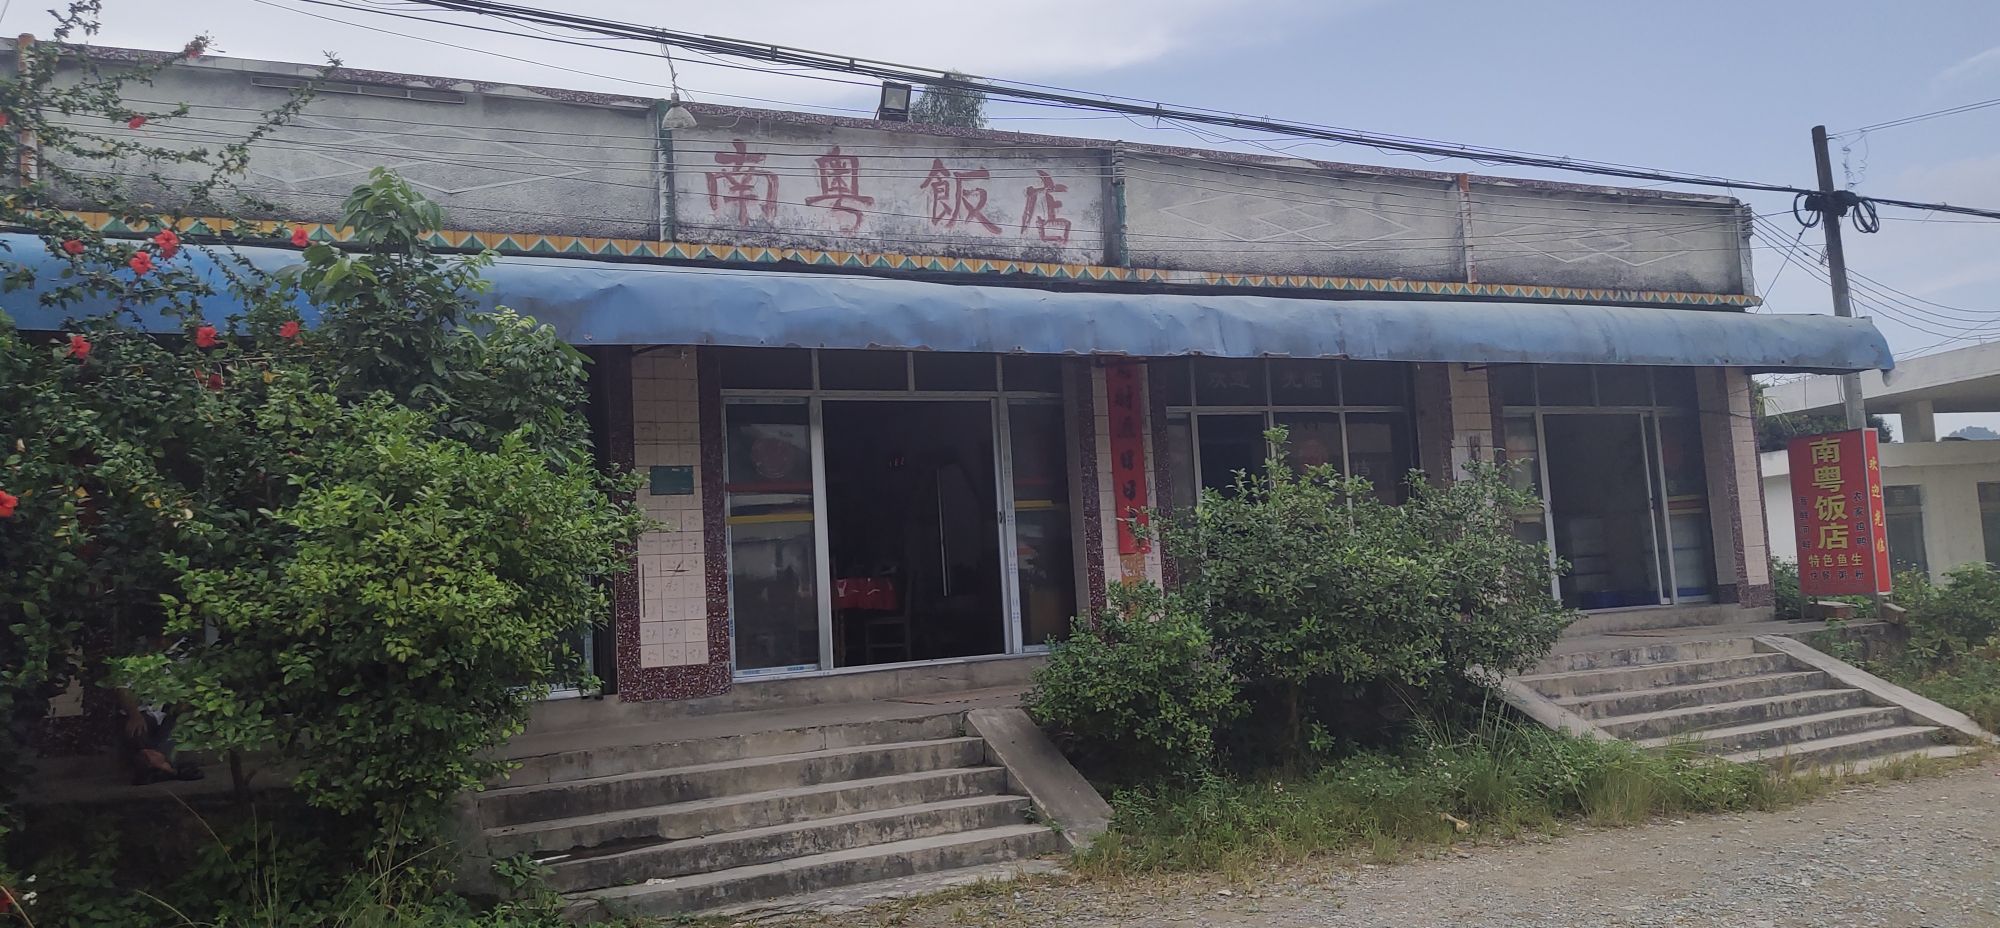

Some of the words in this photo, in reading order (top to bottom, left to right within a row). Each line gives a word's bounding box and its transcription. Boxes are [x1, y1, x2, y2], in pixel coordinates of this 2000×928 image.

[1809, 437, 1849, 550] 南粤饭店
[1868, 456, 1886, 554] 欢迎光临
[1808, 553, 1863, 568] 特色鱼生
